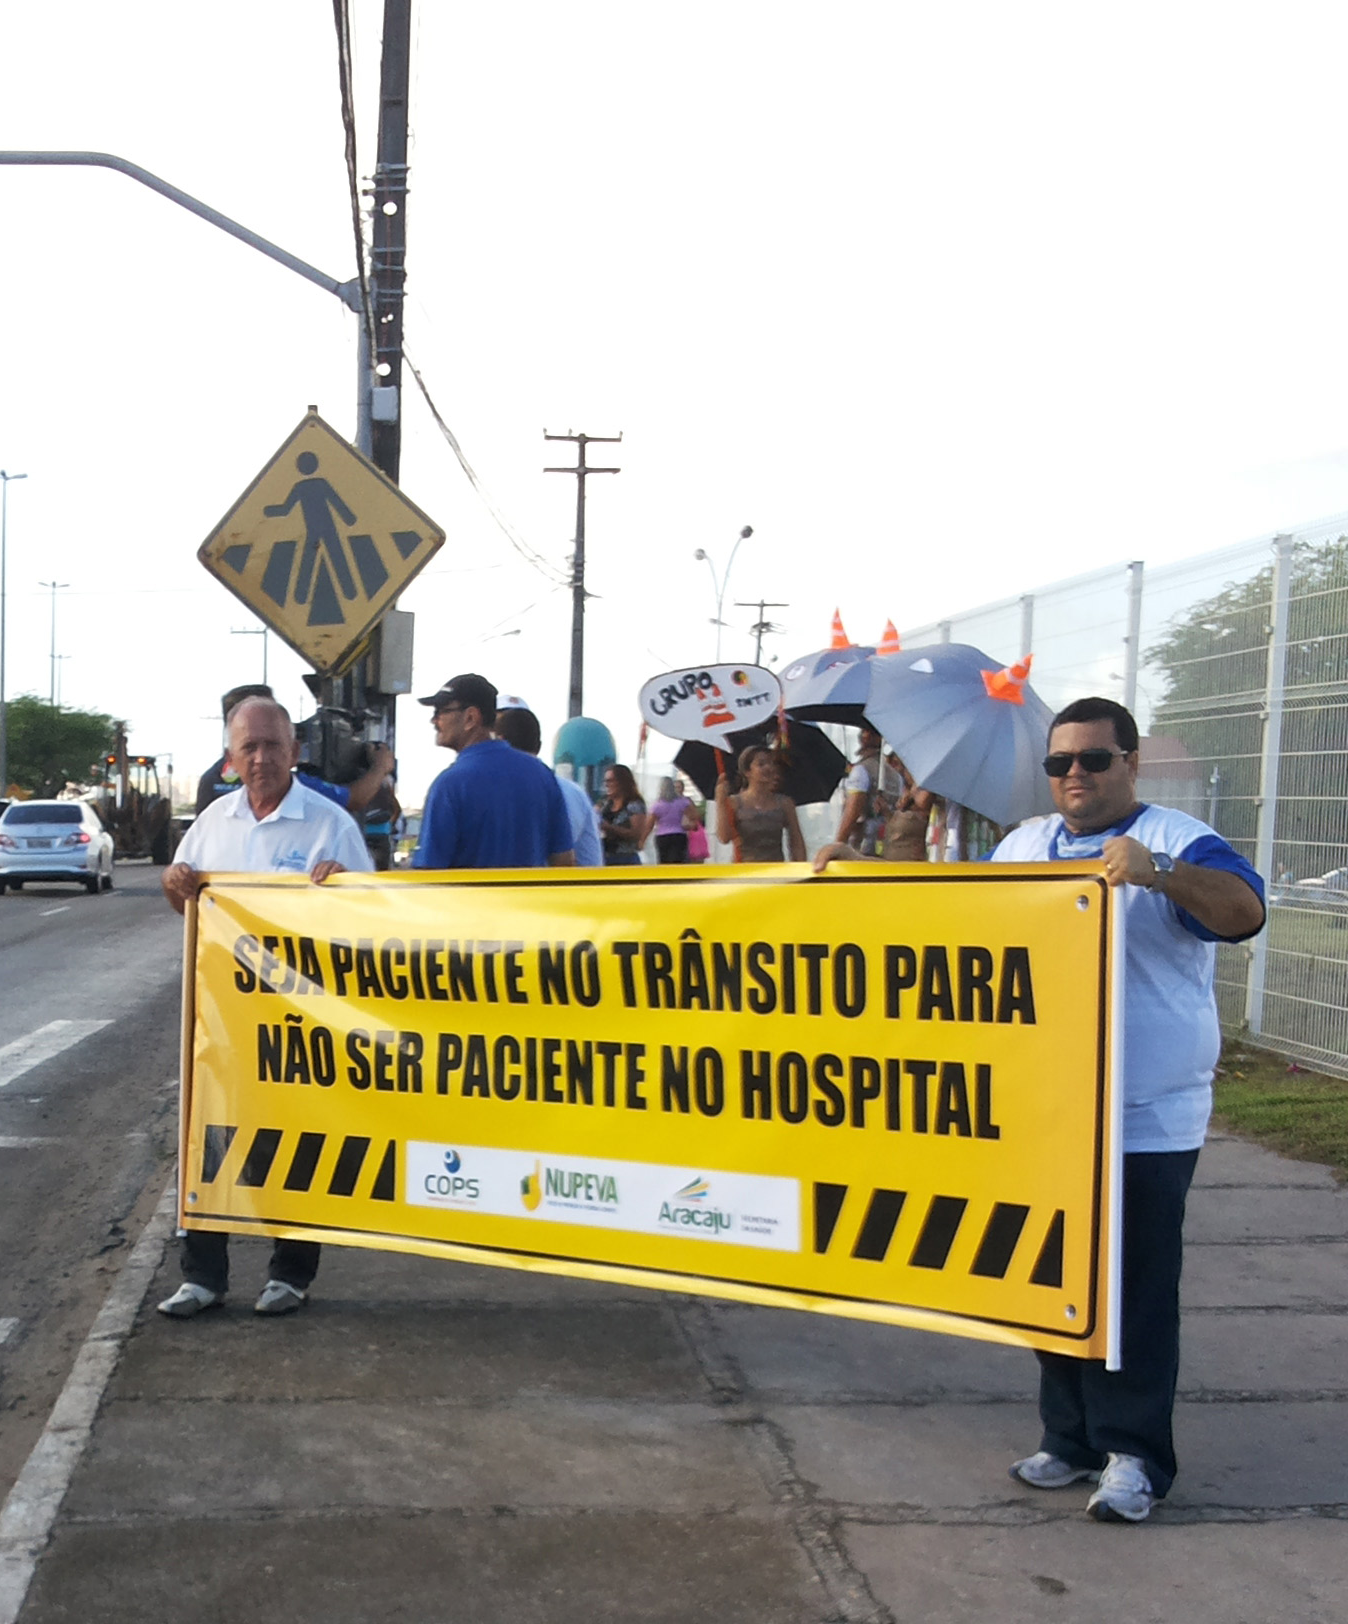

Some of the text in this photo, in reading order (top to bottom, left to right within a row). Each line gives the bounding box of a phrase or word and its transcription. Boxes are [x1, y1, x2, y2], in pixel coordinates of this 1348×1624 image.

[233, 928, 1036, 1025] SEJA PACIENTE NO TRÂNSITO PARA
[257, 1014, 1000, 1140] NÃO SER PACIENTE NO HOSPITAL
[424, 1174, 479, 1199] COPS
[545, 1167, 619, 1205] NUPEVA
[658, 1201, 731, 1235] Aracaju
